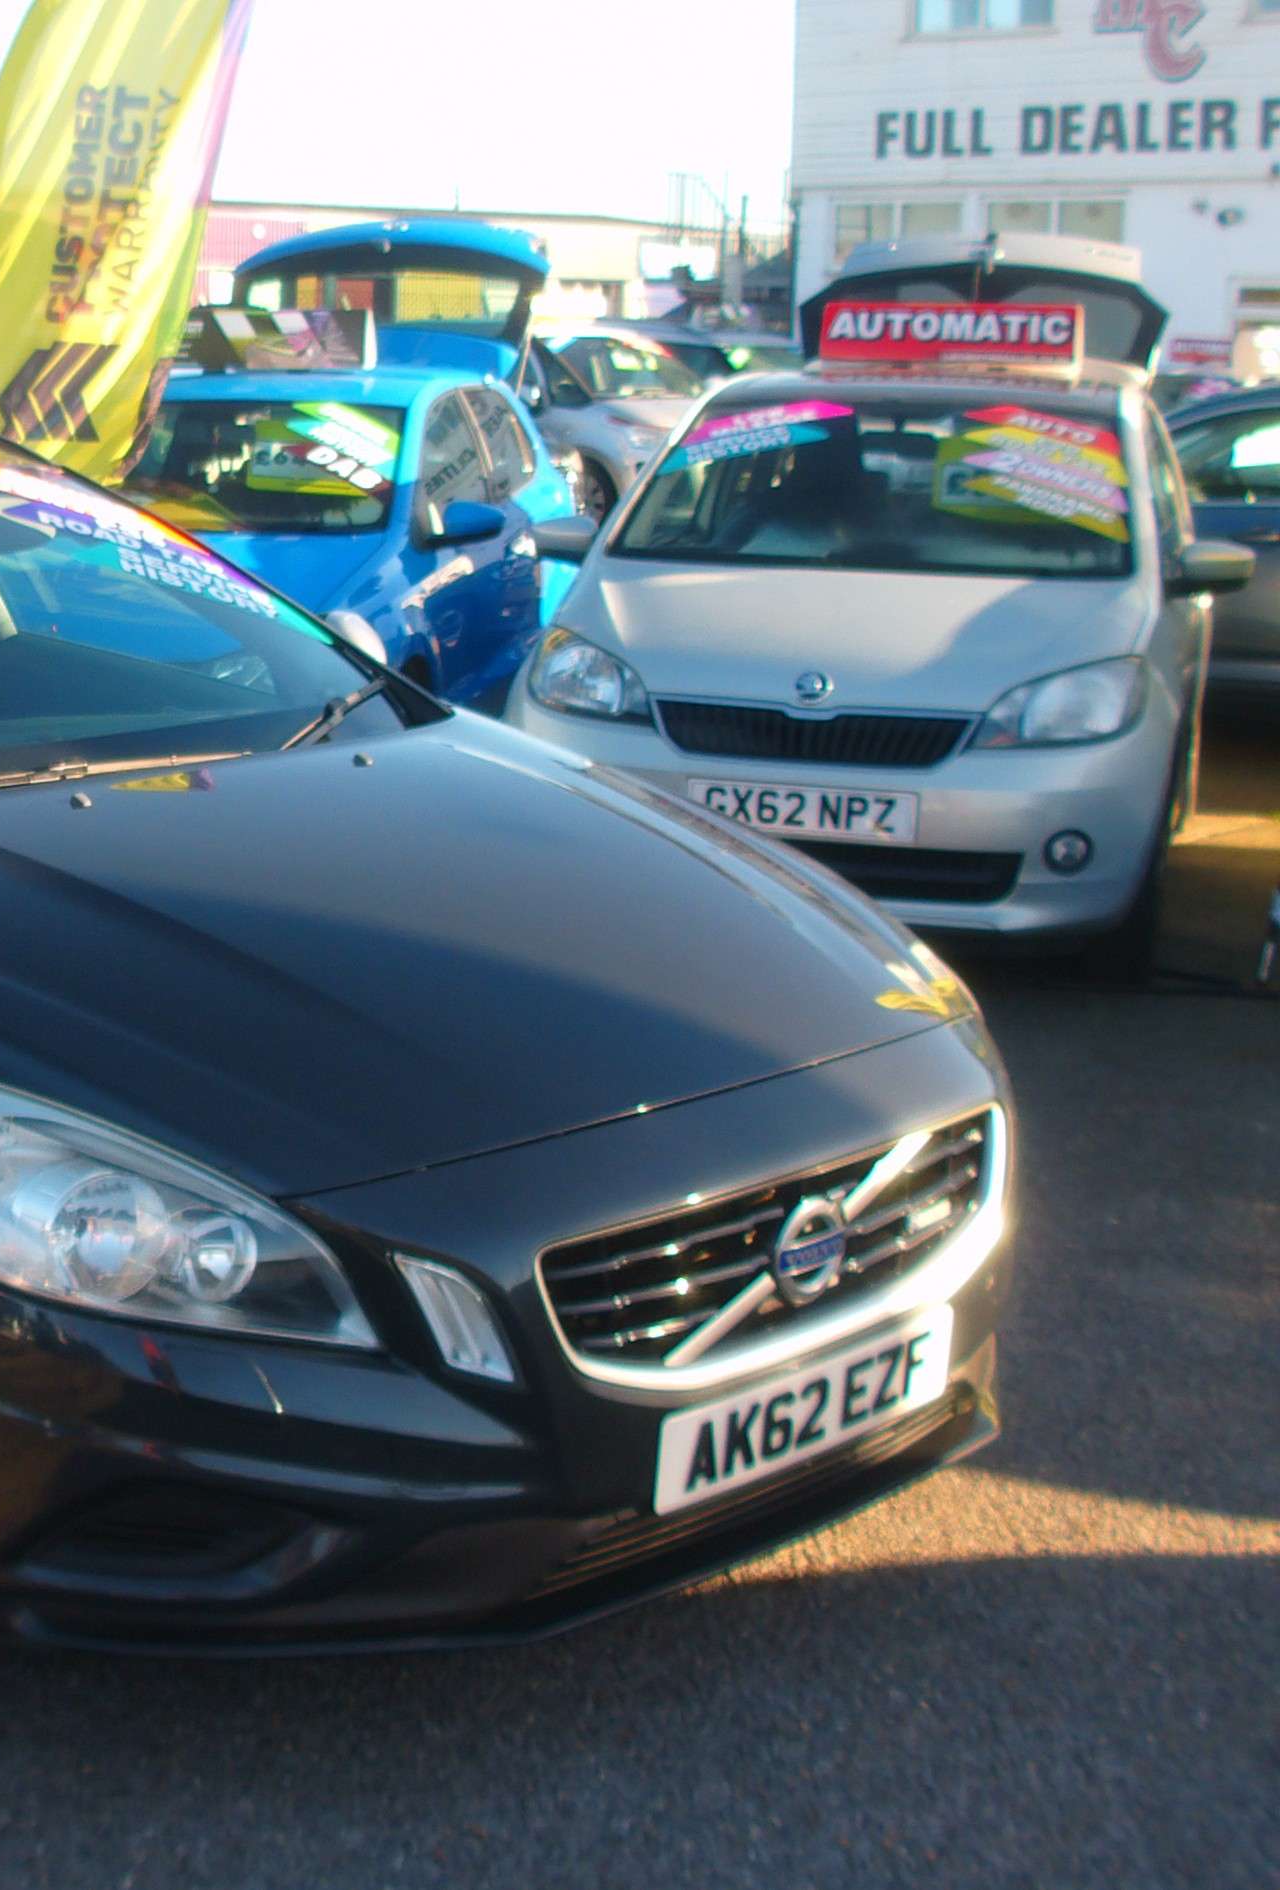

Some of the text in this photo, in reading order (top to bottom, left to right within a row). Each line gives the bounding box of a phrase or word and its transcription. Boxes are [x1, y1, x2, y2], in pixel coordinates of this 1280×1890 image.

[875, 107, 993, 160] FULL
[1019, 98, 1238, 156] DEALER
[46, 82, 108, 324] CUSTOMER
[828, 310, 1074, 345] AUTOMATIC
[1006, 414, 1096, 446] AUTO
[1020, 463, 1117, 500] OWNERS
[37, 510, 142, 549] ROAD
[117, 546, 276, 604] SERVICE
[121, 560, 280, 619] HISTORY
[704, 786, 898, 835] GX62 NPZ
[684, 1330, 934, 1494] AK62 EZF
